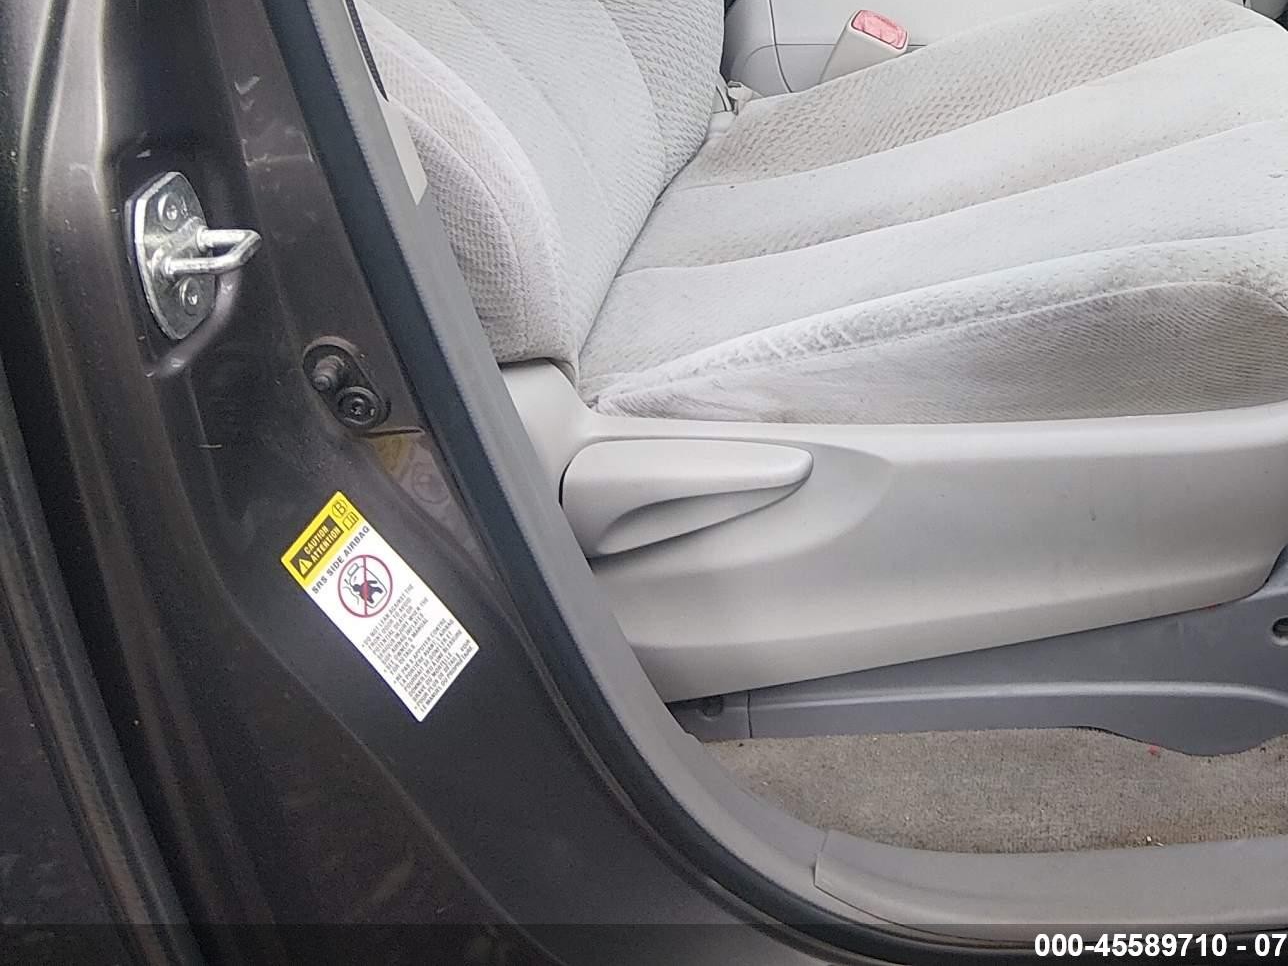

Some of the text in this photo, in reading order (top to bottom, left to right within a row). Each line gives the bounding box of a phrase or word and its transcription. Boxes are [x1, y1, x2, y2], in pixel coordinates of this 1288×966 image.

[302, 524, 329, 555] CAUTION
[309, 526, 341, 563] ATTENTION
[311, 524, 370, 594] SRS SIDE AIRBAG
